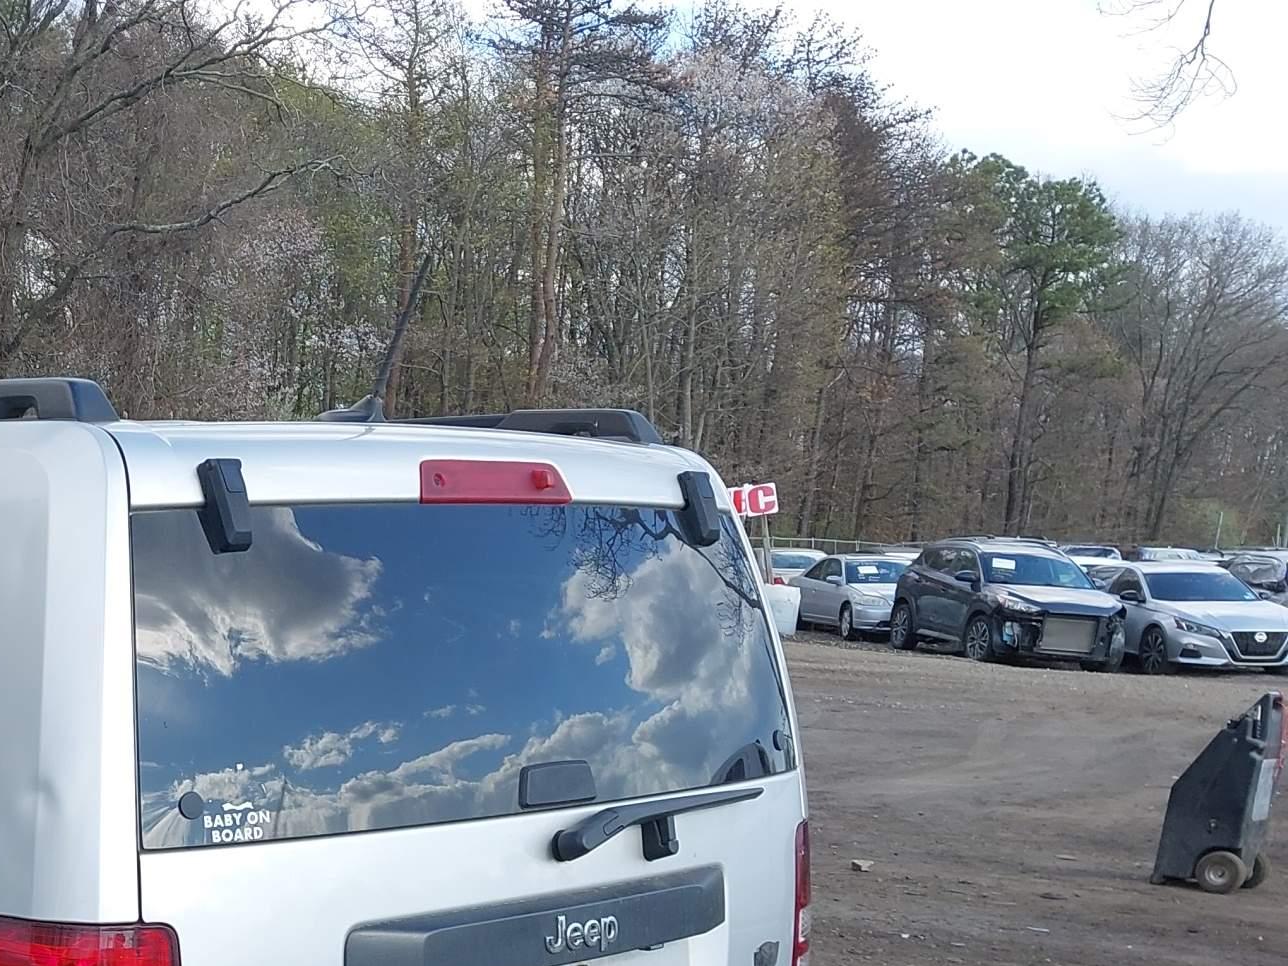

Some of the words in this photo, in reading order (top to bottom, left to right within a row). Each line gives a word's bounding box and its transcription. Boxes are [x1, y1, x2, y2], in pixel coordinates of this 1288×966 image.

[748, 486, 776, 513] C
[203, 813, 242, 828] BABY
[247, 810, 270, 825] ON
[212, 826, 263, 843] BOARD
[544, 914, 618, 954] Jeep
